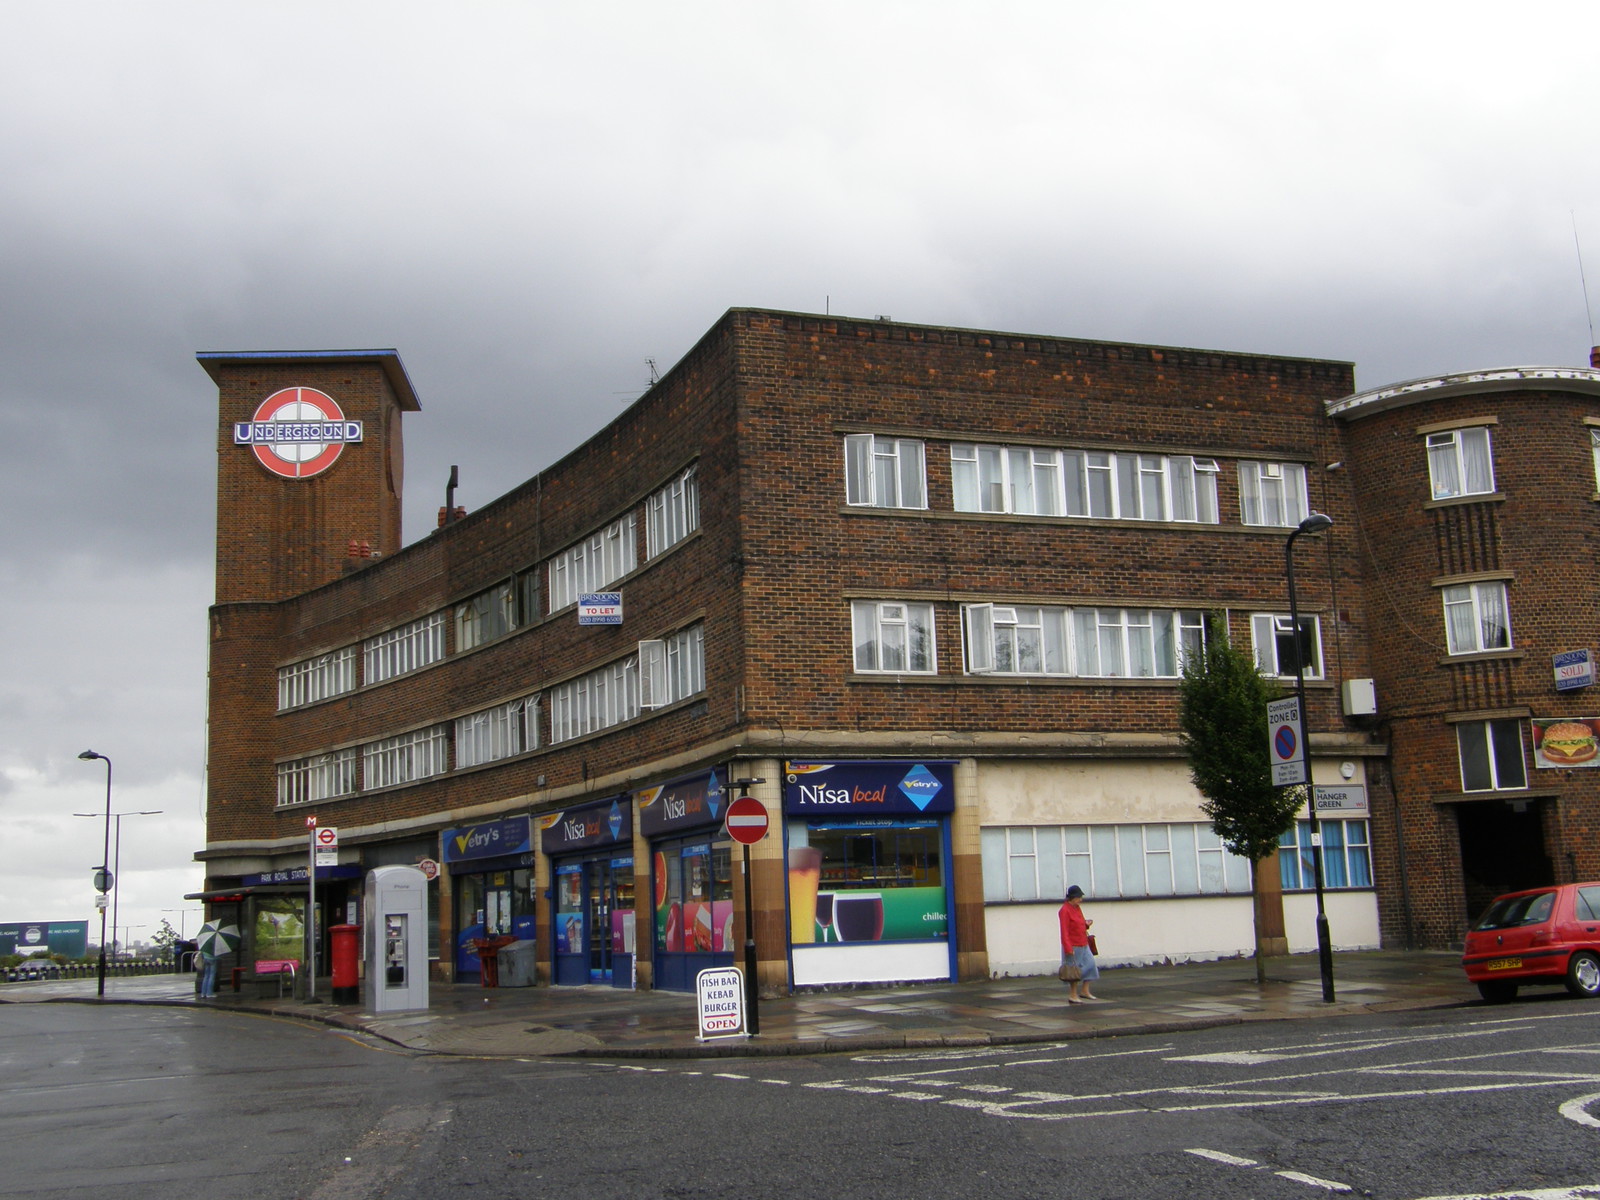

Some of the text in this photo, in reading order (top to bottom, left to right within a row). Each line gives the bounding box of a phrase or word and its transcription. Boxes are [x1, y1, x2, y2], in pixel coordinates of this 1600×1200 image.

[236, 422, 361, 441] UNDERGROUND
[581, 593, 620, 601] BRENDONS
[1561, 665, 1584, 678] SOLD
[1268, 701, 1297, 712] Controlled
[1269, 712, 1290, 724] ZONE
[903, 779, 939, 789] Vetry's
[799, 782, 886, 805] Nisa local
[663, 793, 685, 820] Nisa
[307, 816, 317, 826] M
[564, 818, 586, 841] Nisa
[456, 828, 499, 855] Vetry's
[261, 873, 272, 883] PARK
[274, 872, 289, 882] ROYAL
[701, 976, 738, 988] FISH BAR
[707, 989, 734, 1000] KEBAB
[704, 1002, 737, 1013] BURGER
[706, 1019, 737, 1030] OPEN
